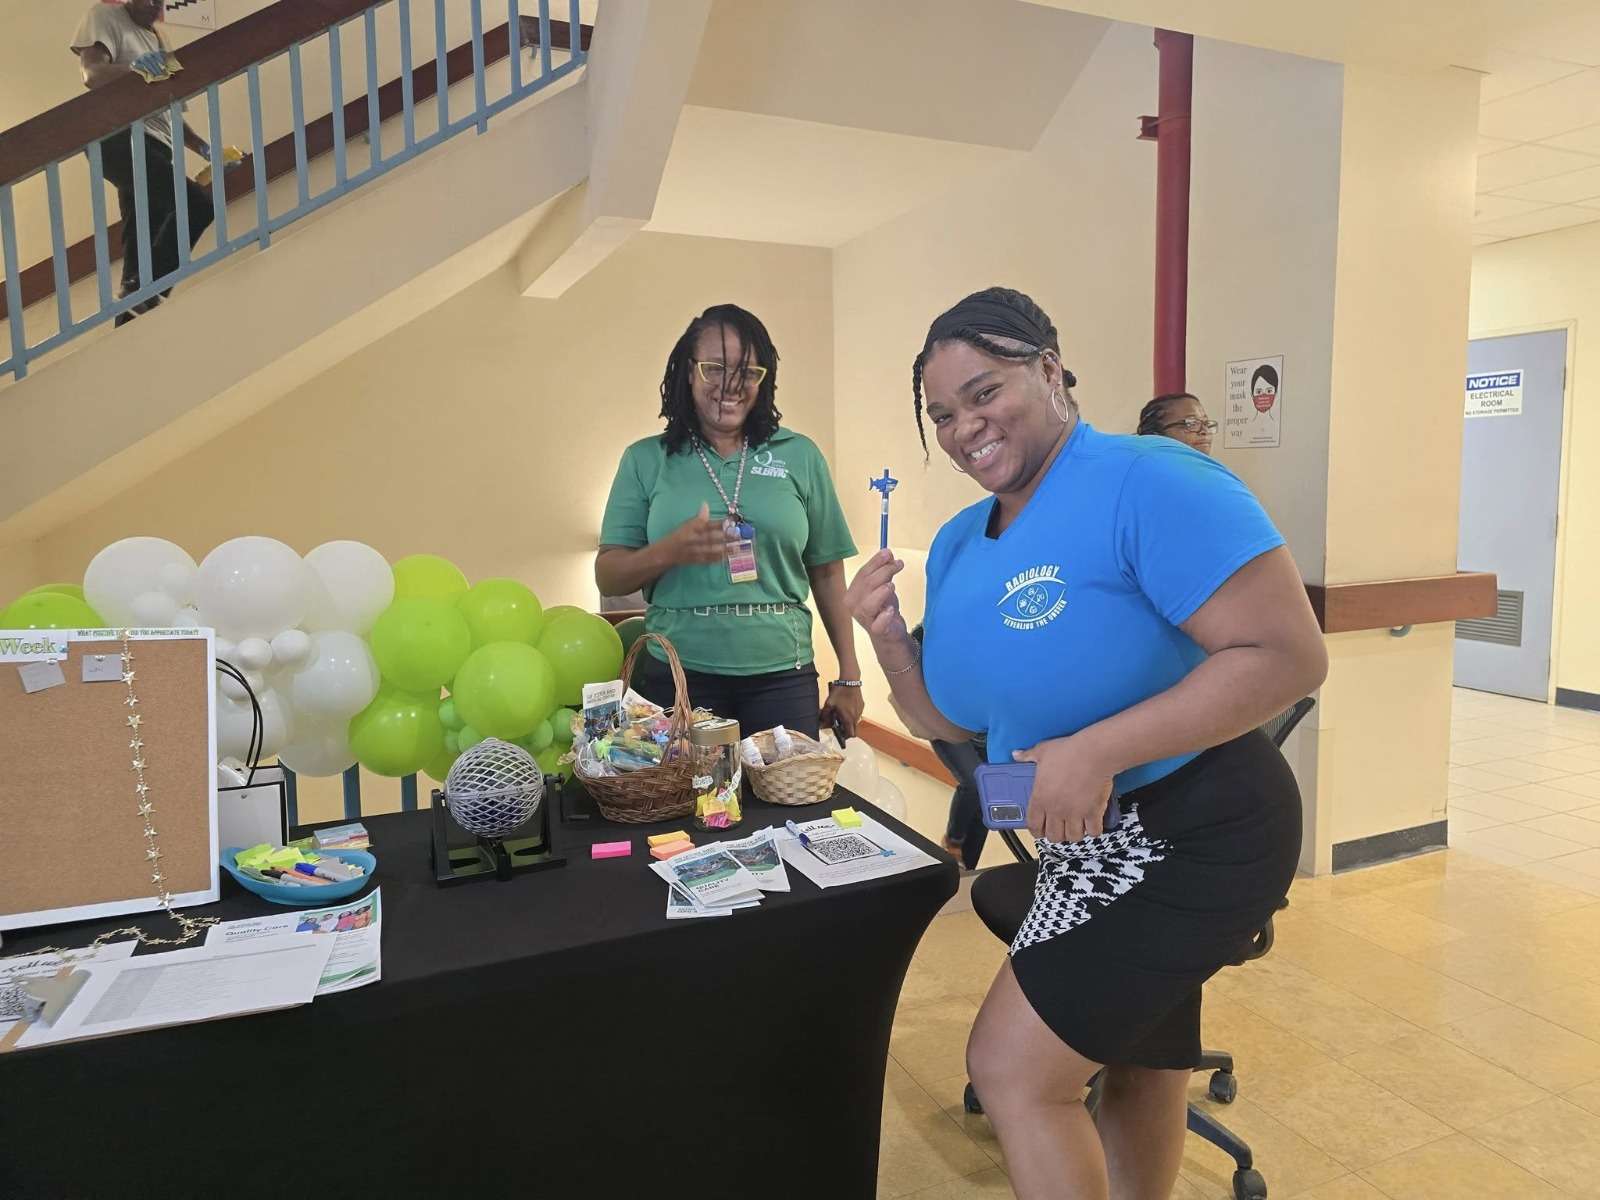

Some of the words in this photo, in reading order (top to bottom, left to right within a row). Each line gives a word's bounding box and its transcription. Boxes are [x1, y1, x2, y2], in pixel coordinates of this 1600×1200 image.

[1230, 367, 1247, 375] Wear
[1231, 380, 1245, 389] your
[1468, 374, 1519, 389] NOTICE
[1230, 390, 1246, 400] mask
[1470, 389, 1515, 400] ELECTRICAL
[1232, 402, 1243, 413] the
[1480, 399, 1503, 408] ROOM
[1226, 417, 1249, 426] proper
[1005, 565, 1061, 591] RADIOLOGY
[1036, 617, 1049, 627] THE
[0, 637, 57, 655] Week
[225, 928, 262, 936] Quality
